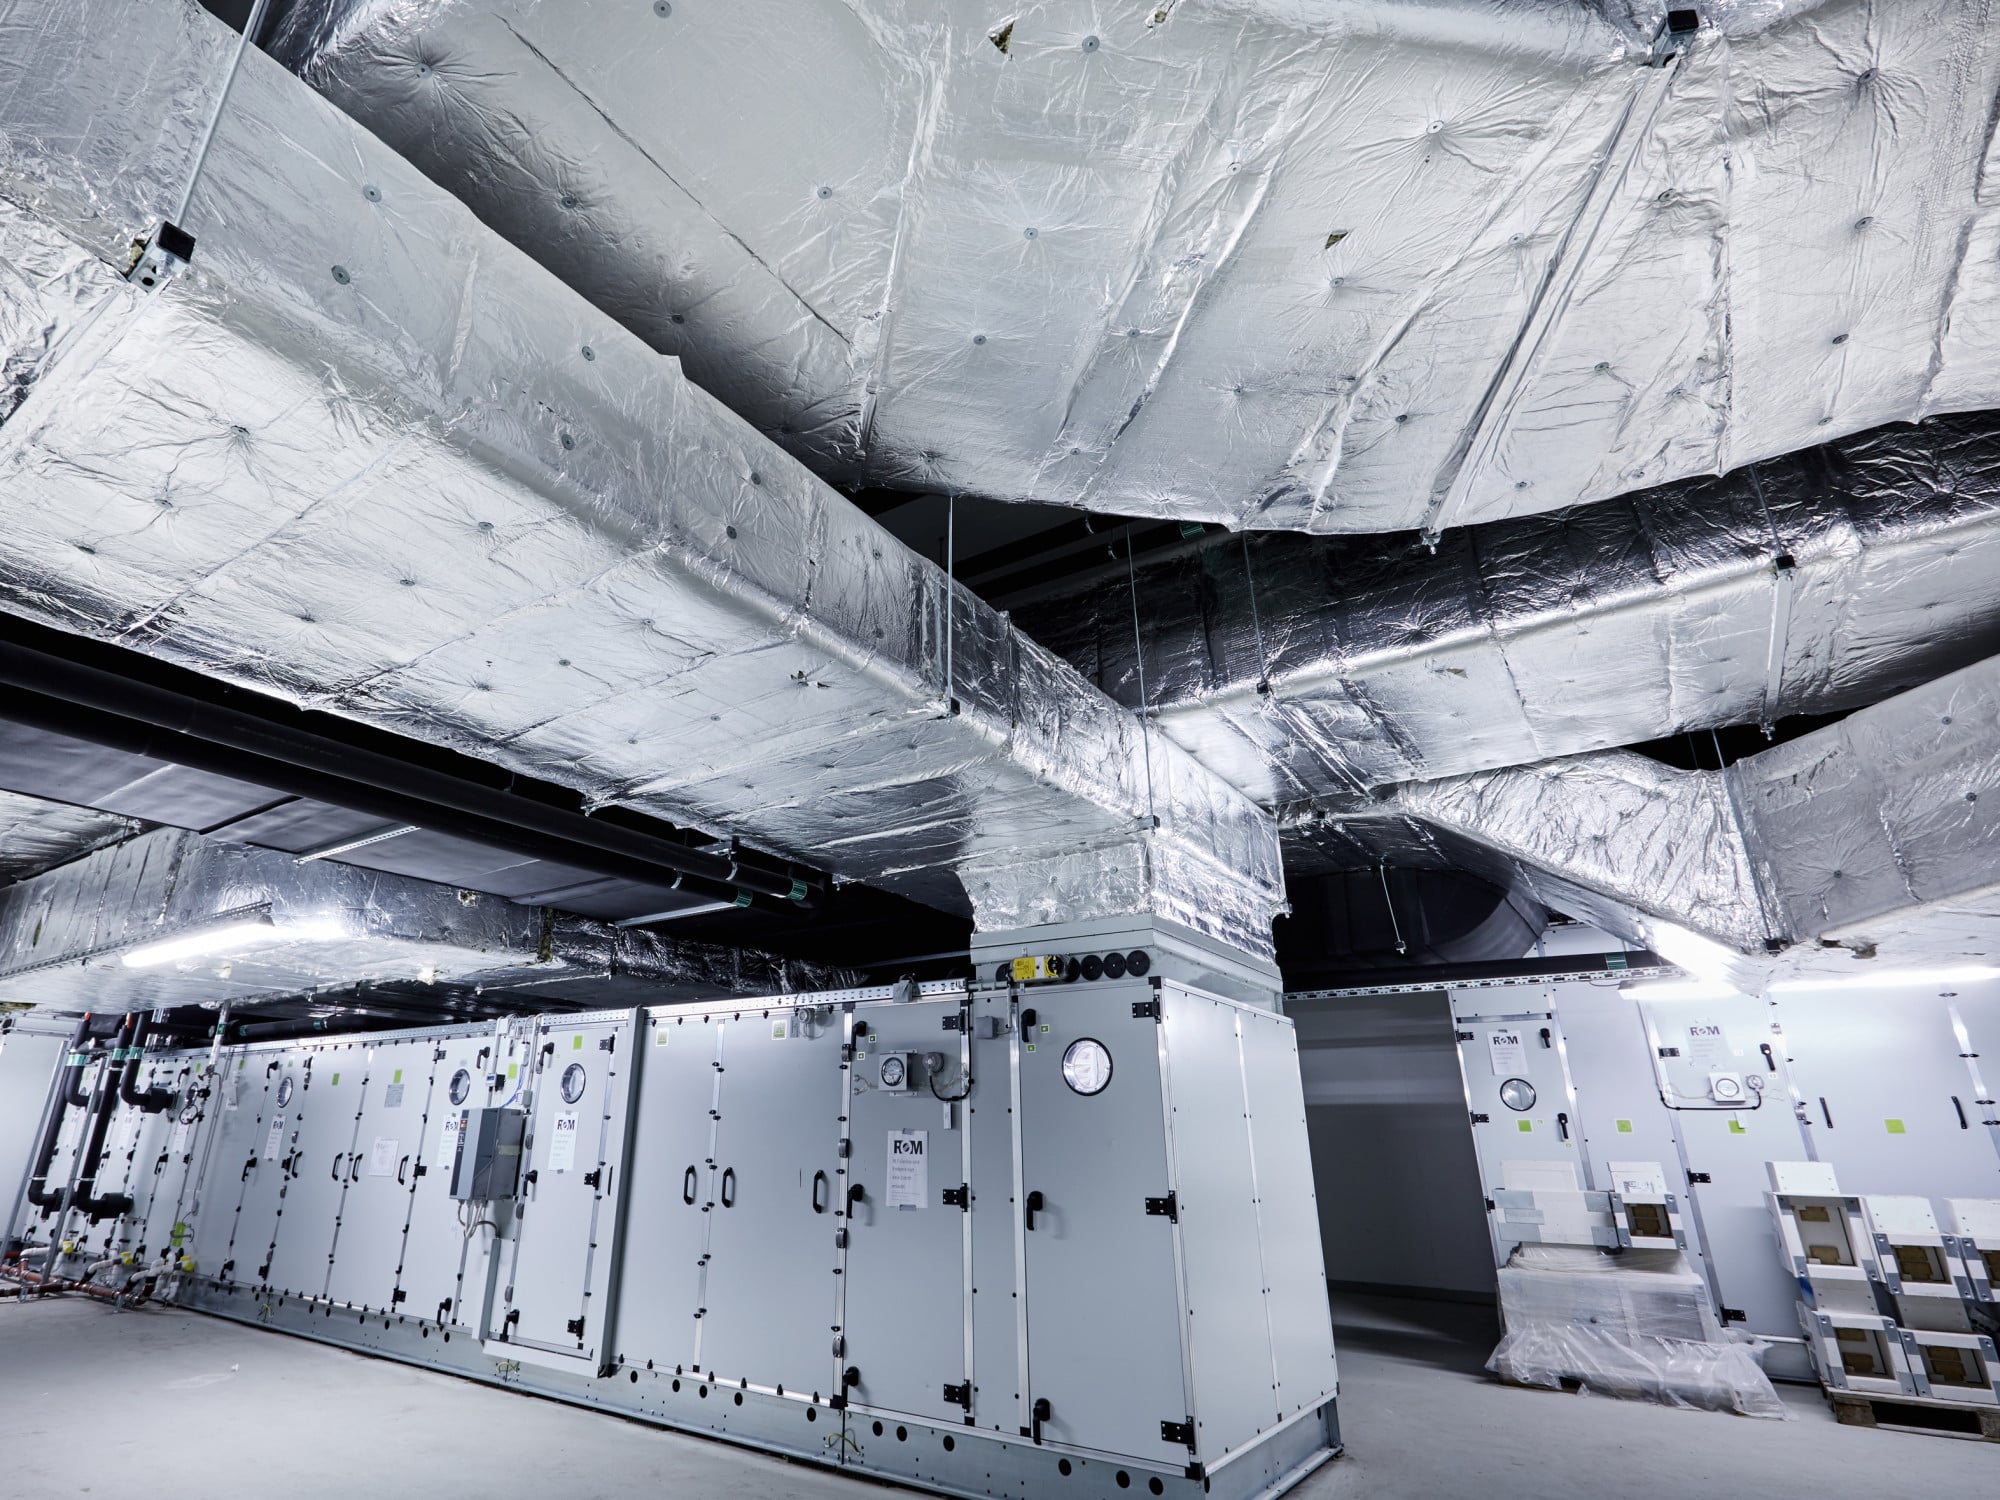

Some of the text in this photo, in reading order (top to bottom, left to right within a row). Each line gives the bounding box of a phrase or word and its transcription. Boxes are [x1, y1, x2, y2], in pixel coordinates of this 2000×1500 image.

[1690, 1026, 1720, 1036] ROM
[1493, 1036, 1518, 1045] ROM
[557, 1120, 575, 1130] ROM
[894, 1140, 923, 1155] ROM
